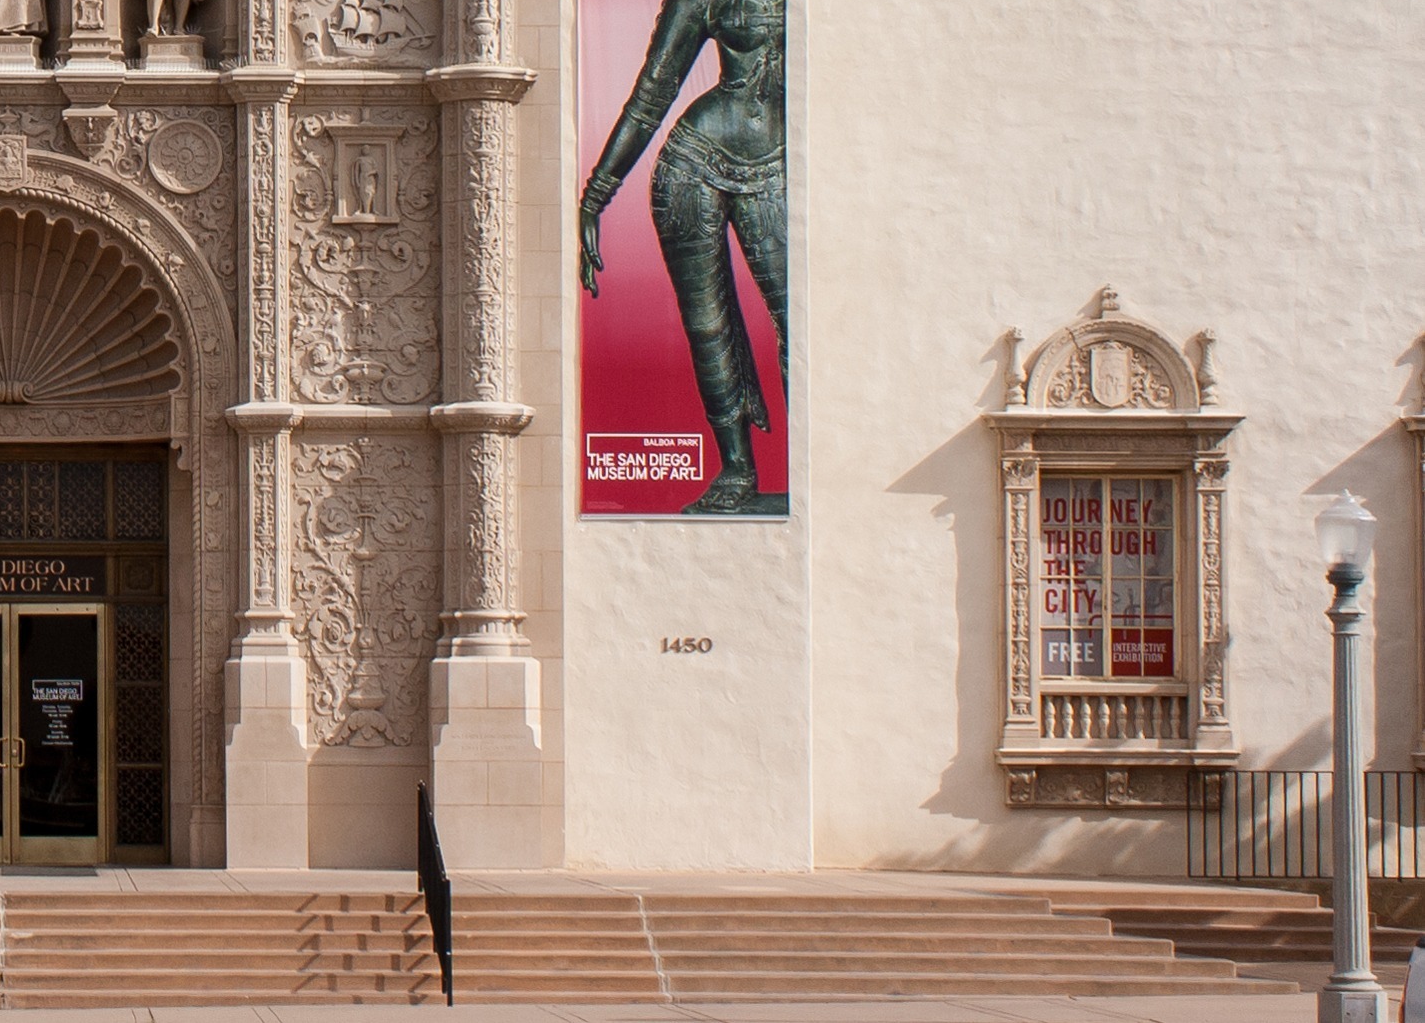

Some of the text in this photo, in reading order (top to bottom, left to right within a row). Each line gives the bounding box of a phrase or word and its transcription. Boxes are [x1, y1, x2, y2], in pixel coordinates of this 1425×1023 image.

[643, 438, 699, 447] BALBOA PARK
[588, 453, 691, 467] THE SAN DIEGO
[587, 467, 697, 480] MUSEUM OF ART
[1043, 498, 1153, 523] JOURNEY
[1044, 530, 1156, 555] THROUGH
[1, 559, 66, 575] DIEGO
[1044, 560, 1085, 585] THE
[20, 577, 48, 592] OF
[52, 577, 94, 592] ART
[1044, 589, 1097, 614] CITY
[660, 637, 713, 654] 1450
[1048, 641, 1095, 663] FREE
[1113, 642, 1167, 653] INTERACTIVE
[1113, 653, 1164, 663] EXHIBITION
